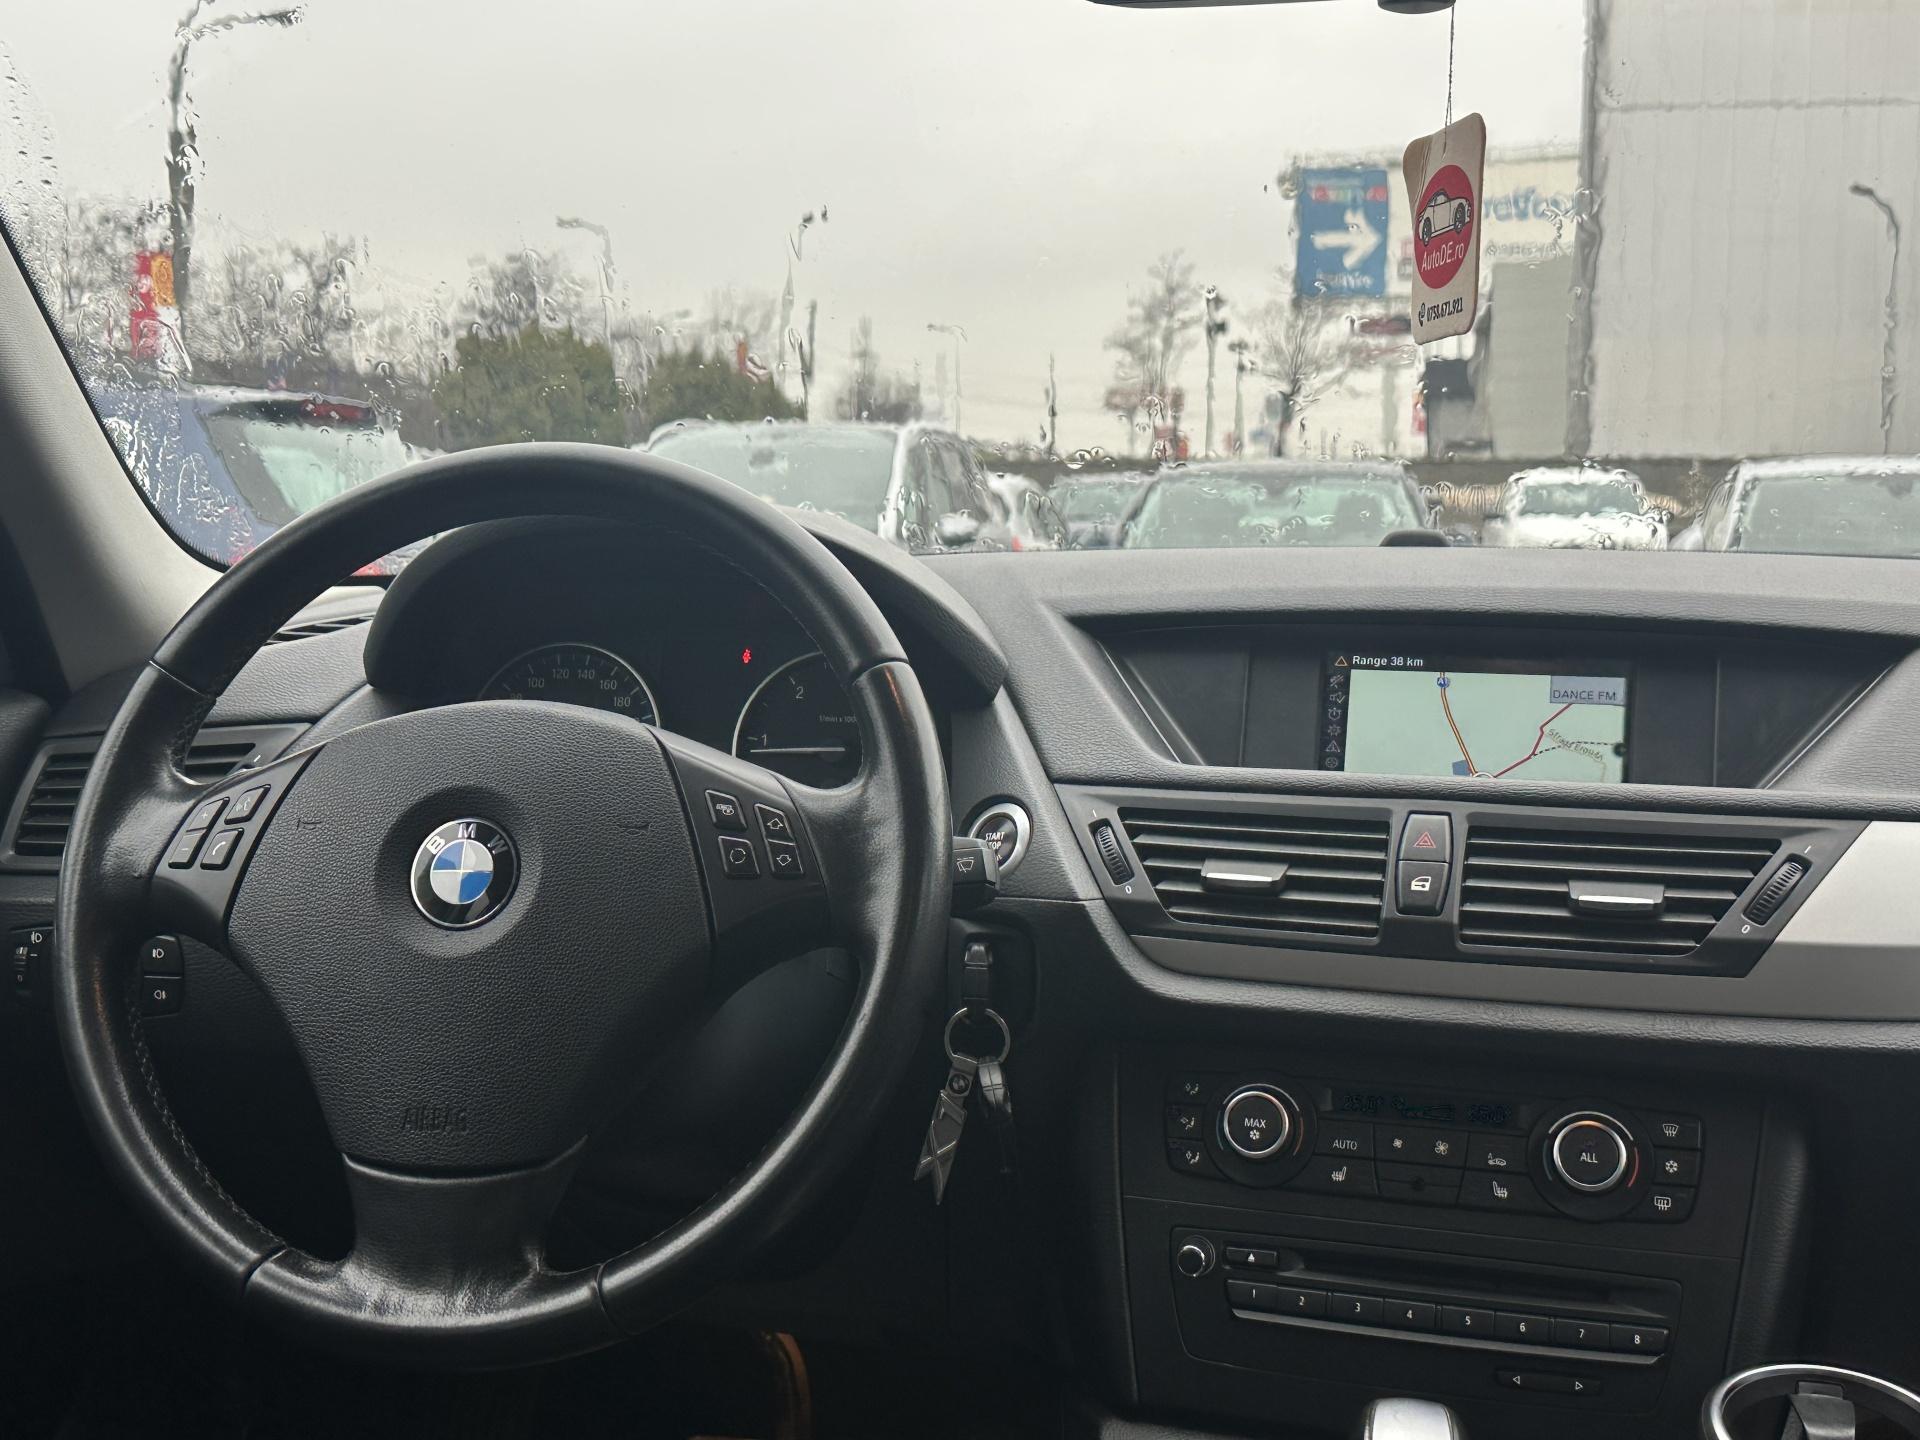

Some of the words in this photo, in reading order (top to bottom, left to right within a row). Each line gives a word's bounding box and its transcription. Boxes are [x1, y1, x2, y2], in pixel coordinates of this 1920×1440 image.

[1421, 241, 1465, 272] AutoDE.ro
[1352, 655, 1387, 667] Range
[1390, 656, 1403, 666] 38
[1406, 657, 1423, 667] km
[552, 668, 570, 679] 120
[577, 669, 596, 680] 140
[527, 677, 545, 688] 100
[600, 679, 618, 690] 160
[795, 686, 804, 699] 2
[1552, 690, 1593, 700] DANCE
[1598, 691, 1616, 701] FM
[613, 696, 631, 707] 180
[761, 733, 767, 746] 1
[425, 822, 509, 855] BMW
[985, 831, 1005, 841] START
[1244, 1117, 1266, 1129] MAX
[1333, 1139, 1358, 1150] AUTO
[1580, 1152, 1598, 1163] ALL
[1252, 1289, 1256, 1299] 1
[1299, 1296, 1305, 1306] 2
[1354, 1302, 1361, 1312] 3
[1406, 1309, 1413, 1319] 4
[1465, 1316, 1471, 1326] 5
[1519, 1322, 1526, 1332] 6
[1578, 1328, 1585, 1338] 7
[1634, 1334, 1641, 1344] 8
